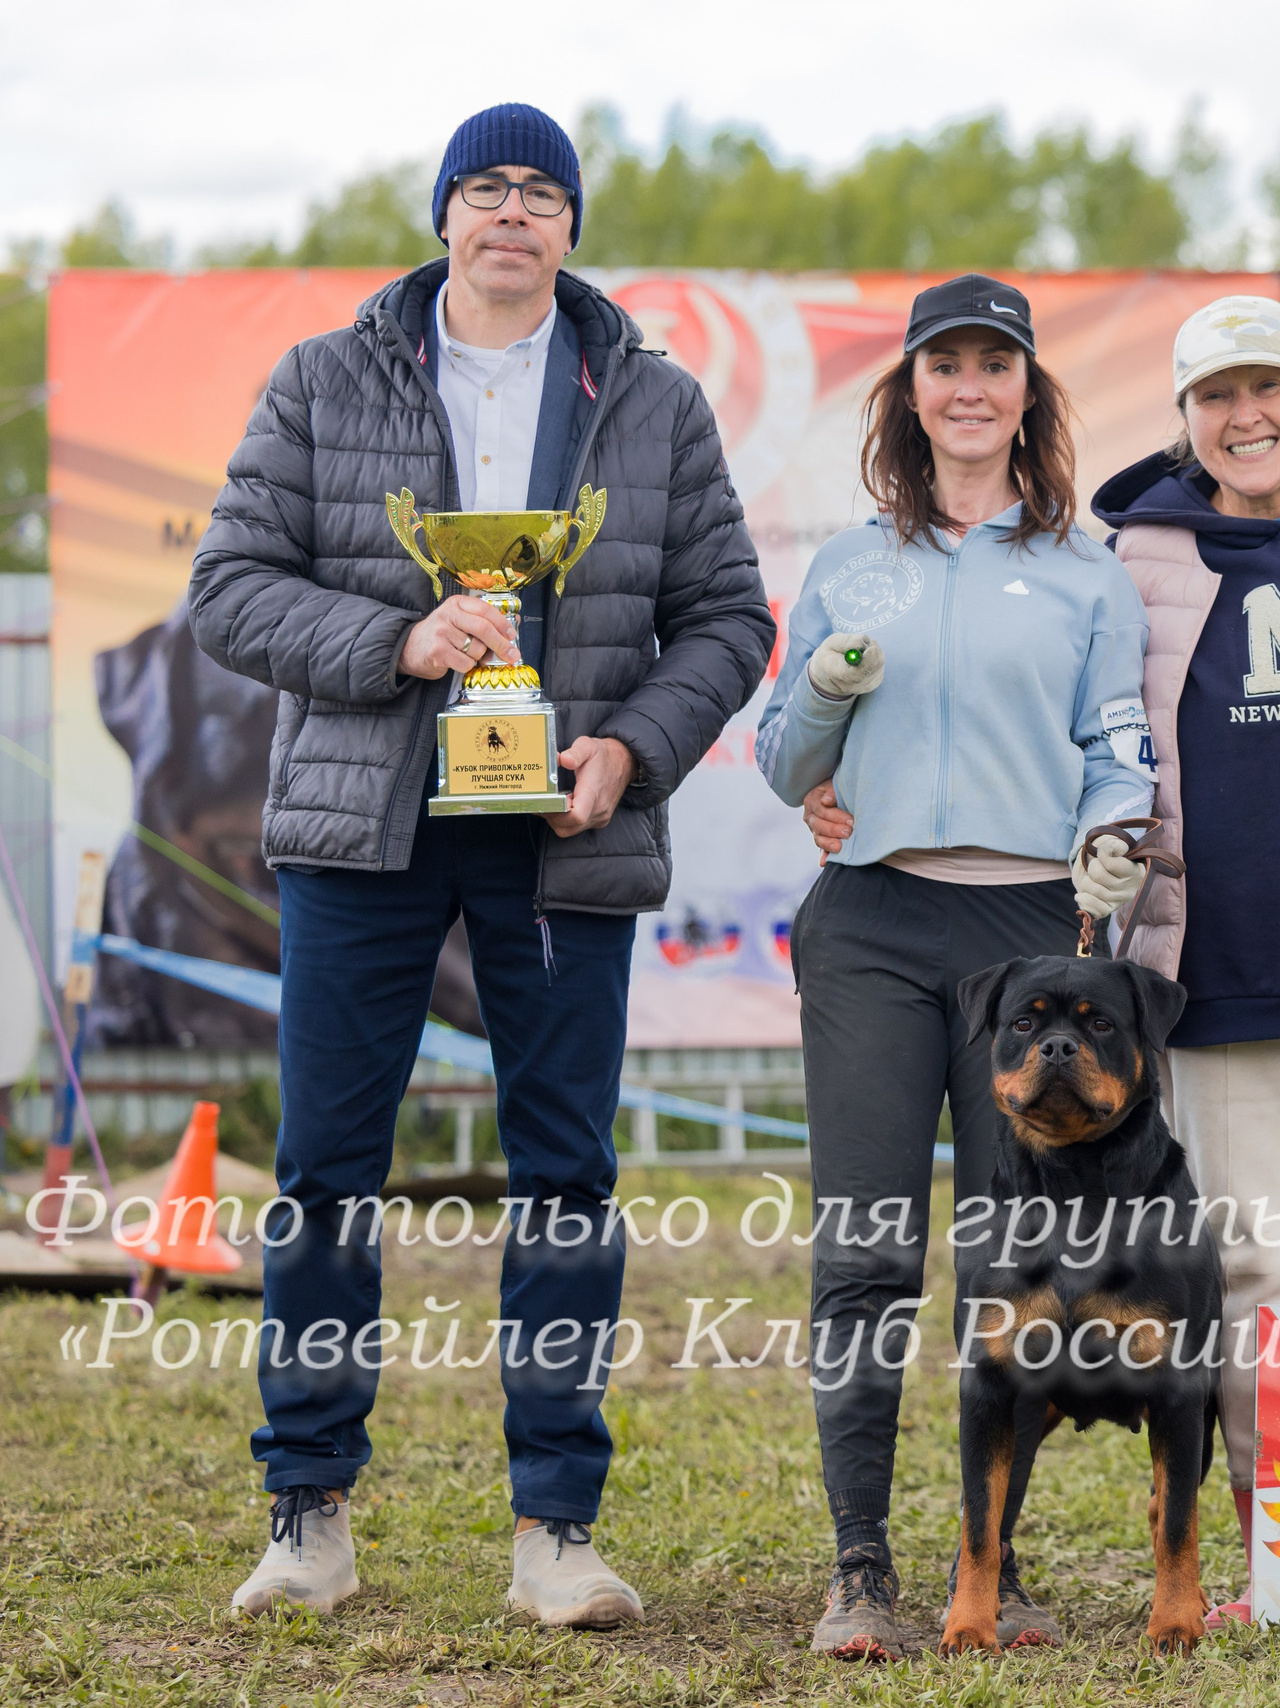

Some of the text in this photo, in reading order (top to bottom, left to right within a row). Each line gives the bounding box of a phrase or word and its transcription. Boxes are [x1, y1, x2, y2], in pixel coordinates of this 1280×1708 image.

[848, 553, 883, 569] DOMA
[832, 611, 895, 632] ROTTWEILER
[1138, 735, 1158, 773] 4
[471, 773, 525, 782] ЛУЧШАЯ СУКА
